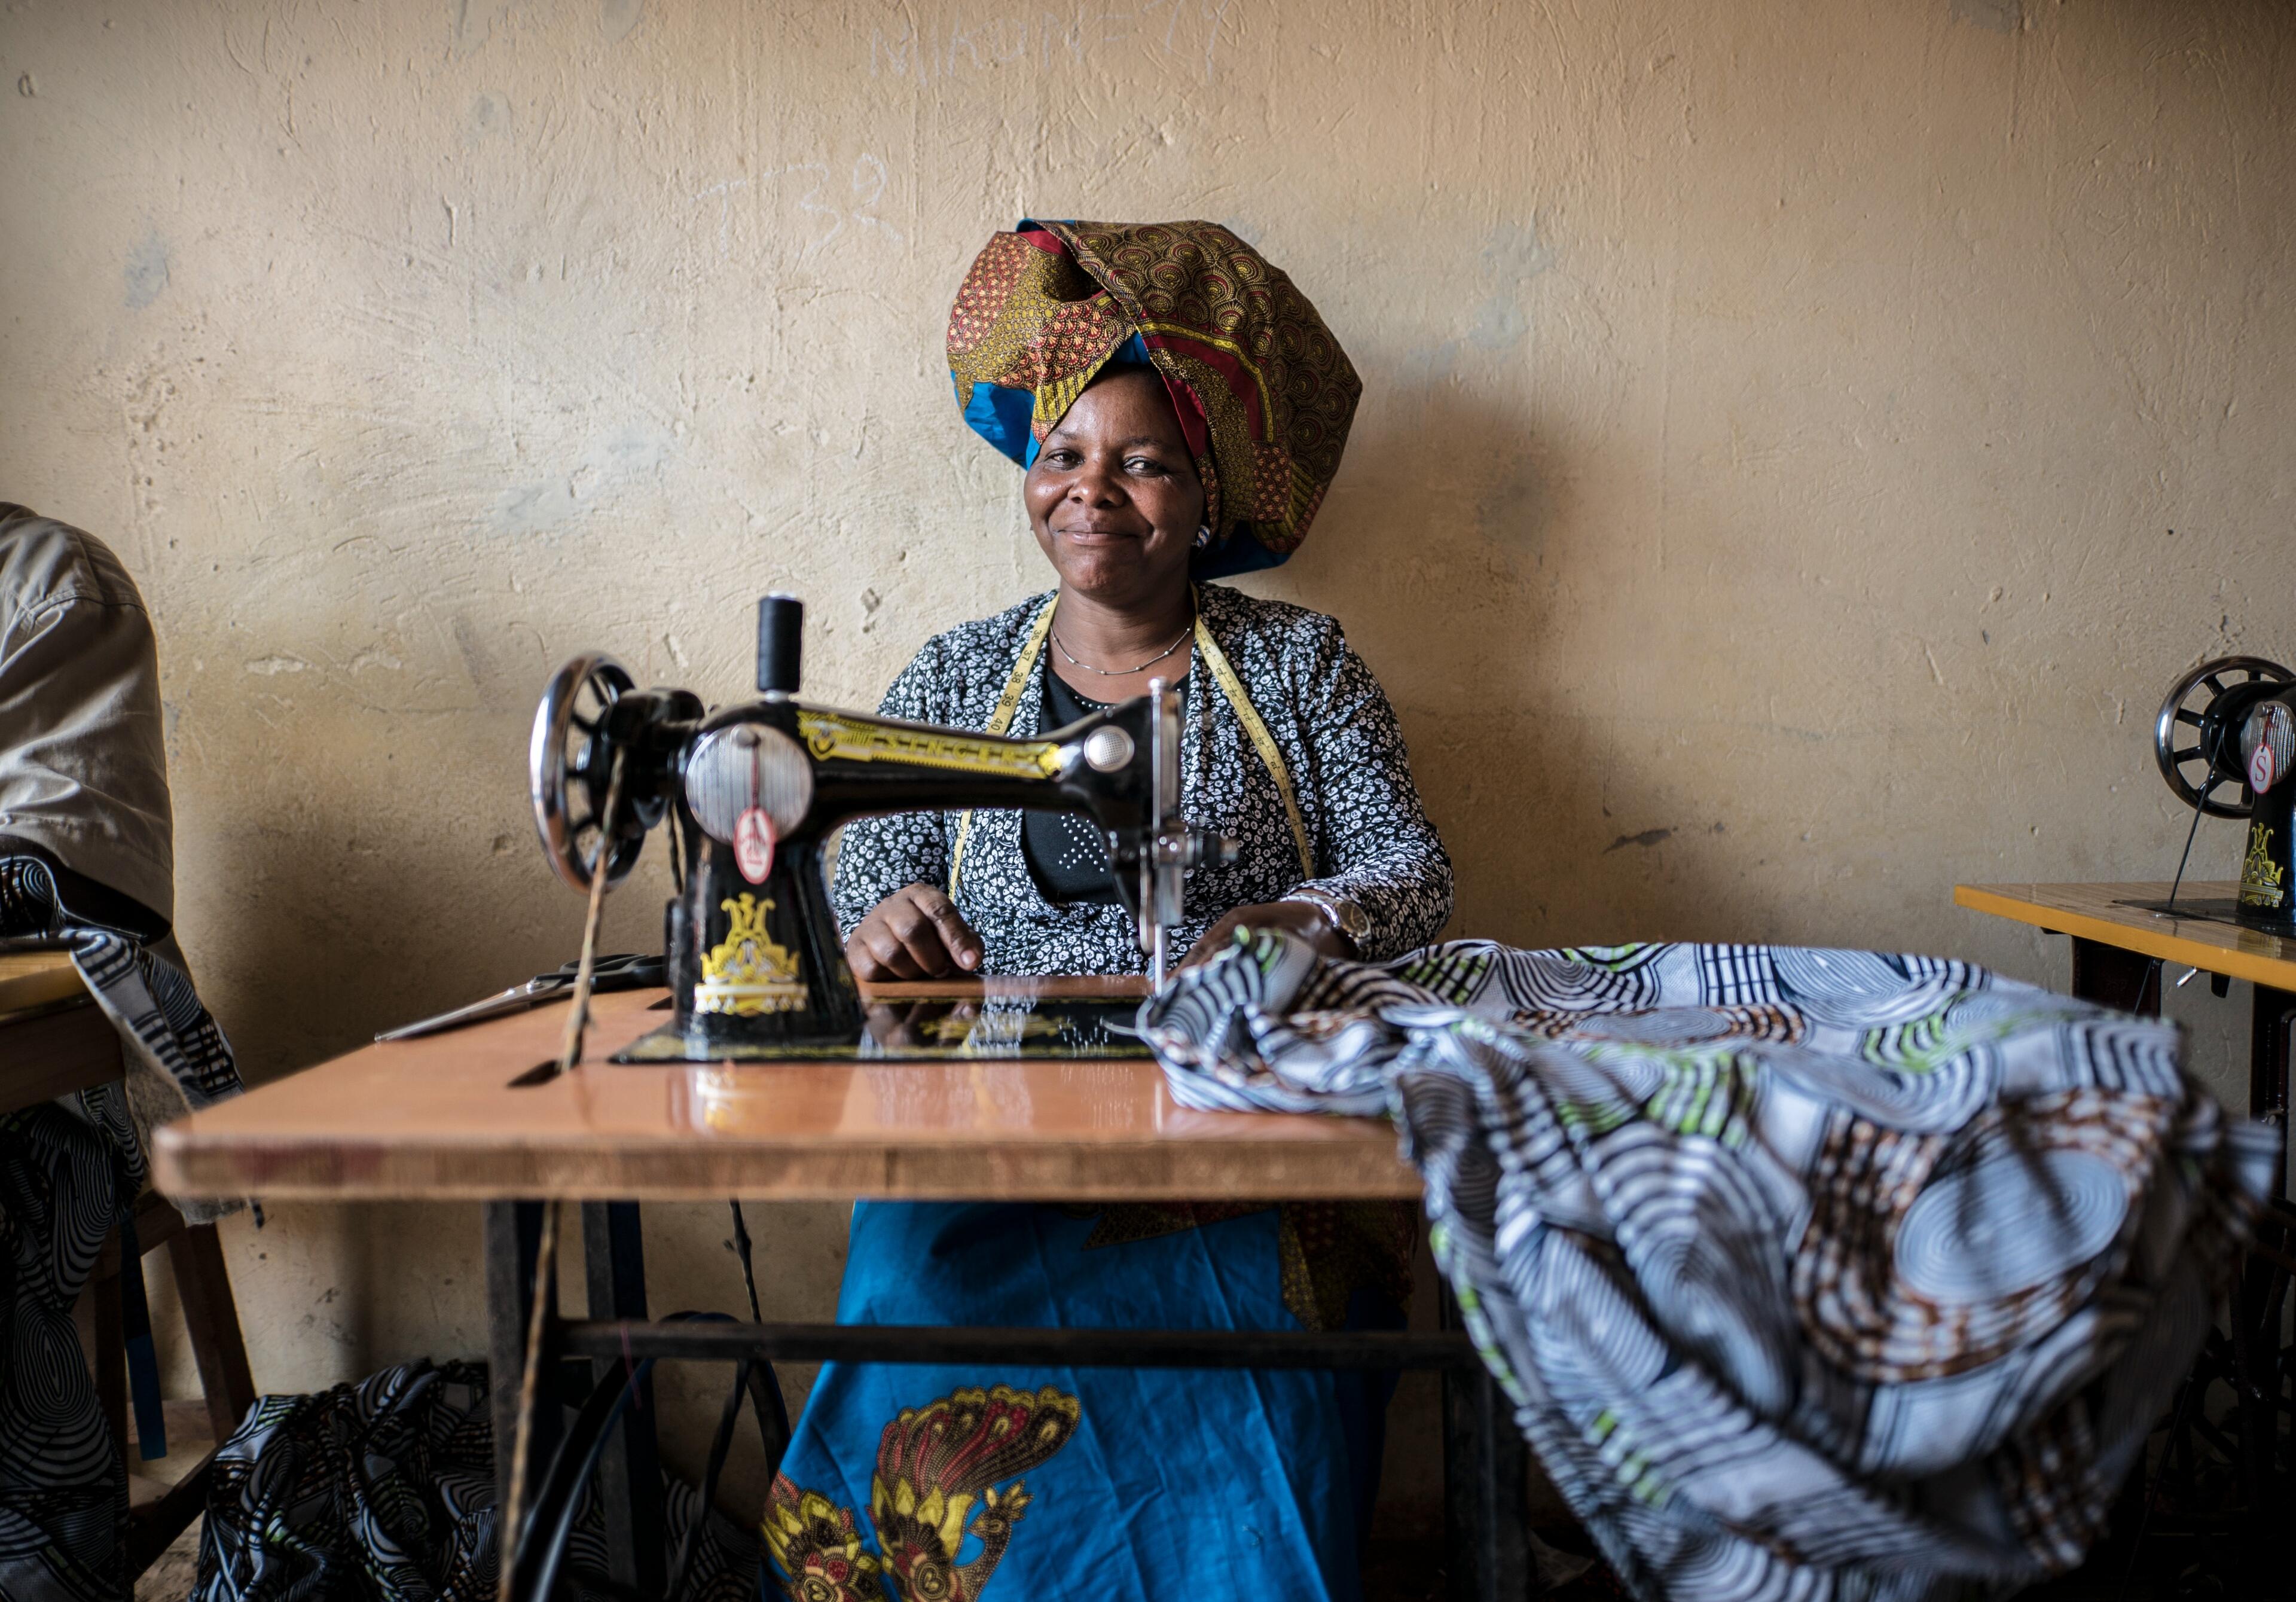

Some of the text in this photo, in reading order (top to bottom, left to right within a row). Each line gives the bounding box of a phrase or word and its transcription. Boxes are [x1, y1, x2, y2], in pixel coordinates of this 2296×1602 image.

[991, 609, 1050, 731] 35 36 37 38 39 40
[1229, 689, 1237, 698] 22
[1243, 713, 1251, 722] 21
[1256, 737, 1264, 746] 20
[885, 736, 1018, 764] SINGER
[1270, 761, 1277, 770] 19
[2255, 755, 2266, 782] S
